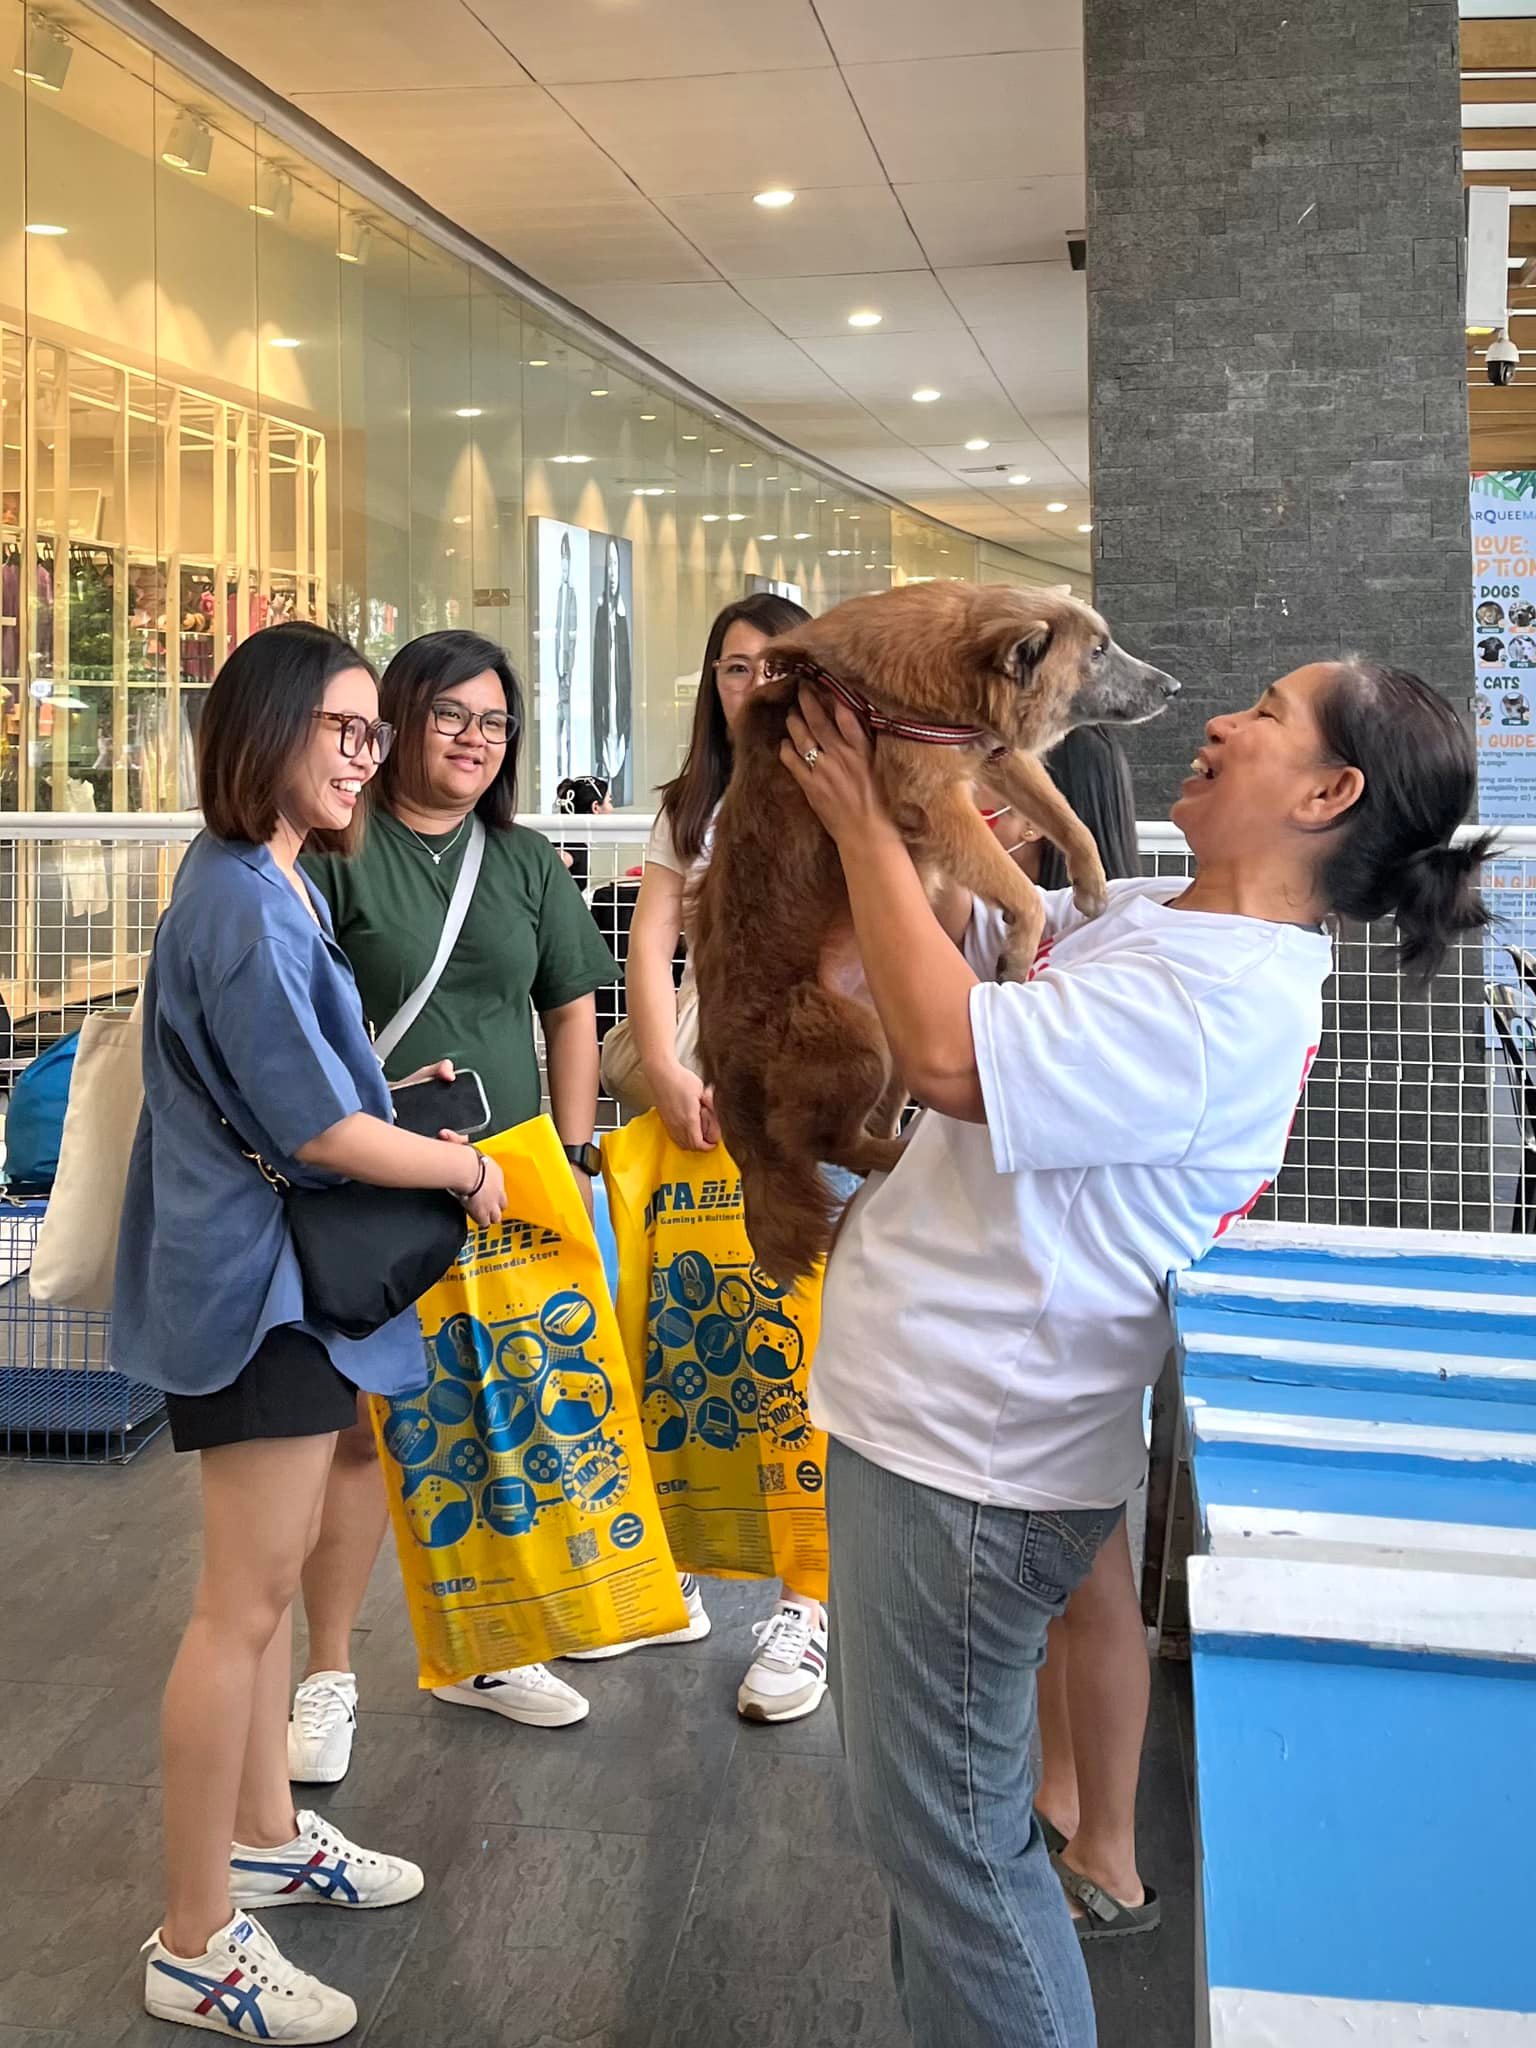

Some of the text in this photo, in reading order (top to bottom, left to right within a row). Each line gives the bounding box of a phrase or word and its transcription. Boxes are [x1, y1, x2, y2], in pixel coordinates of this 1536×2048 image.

[1481, 585, 1520, 599] DOGS
[1483, 676, 1520, 689] CATS
[530, 1249, 559, 1272] Store
